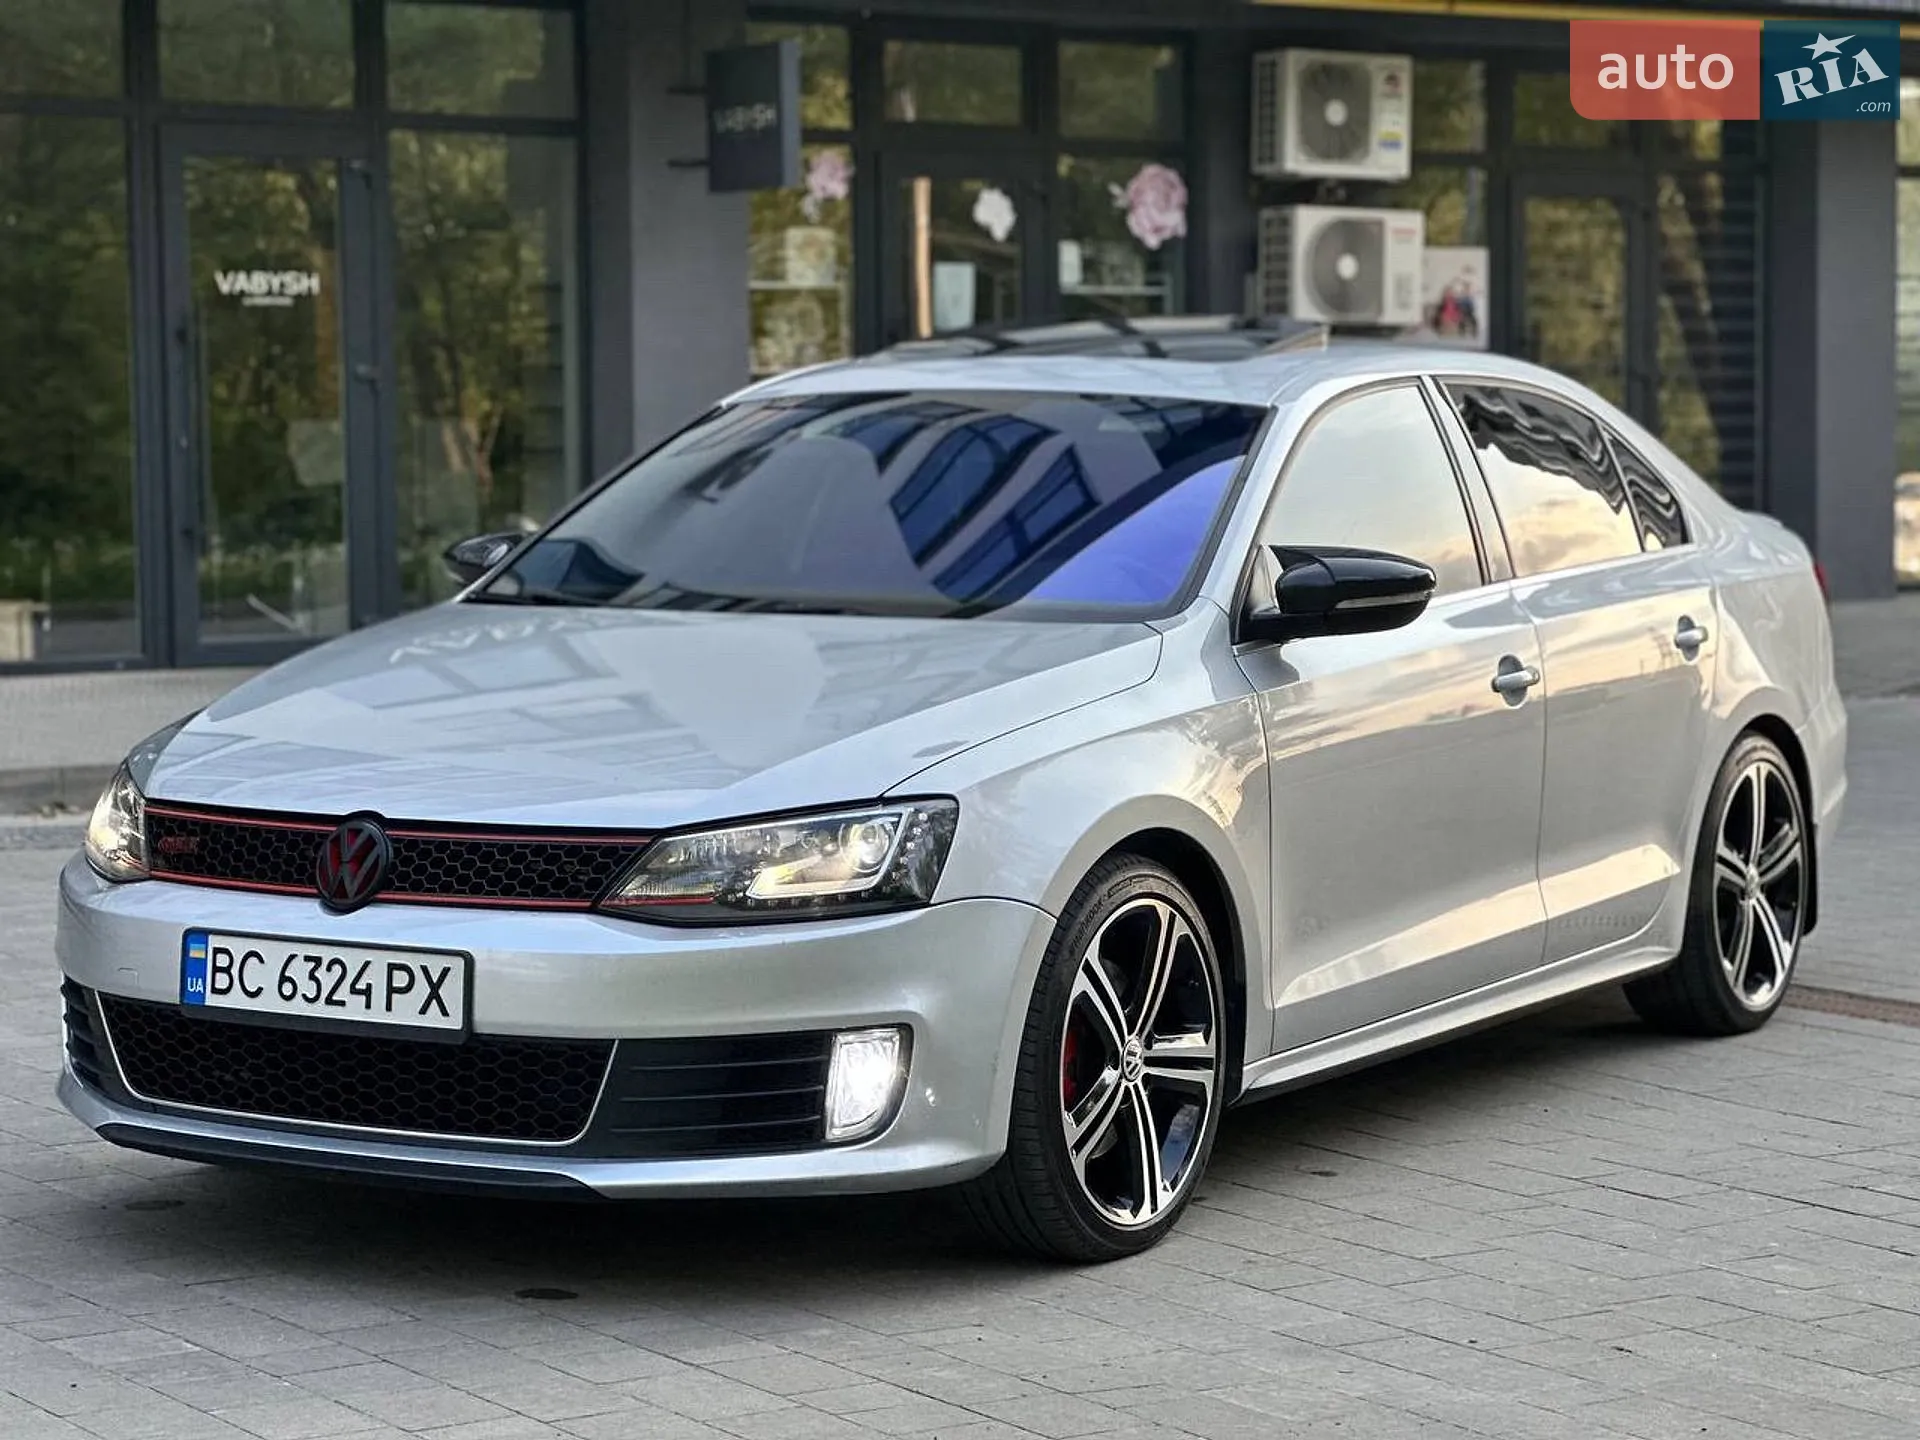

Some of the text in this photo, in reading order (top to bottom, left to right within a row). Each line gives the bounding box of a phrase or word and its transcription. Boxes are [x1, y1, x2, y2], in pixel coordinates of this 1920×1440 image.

[214, 270, 320, 296] VABYSH
[187, 977, 204, 995] UA
[210, 947, 452, 1018] BC 6324 PX
